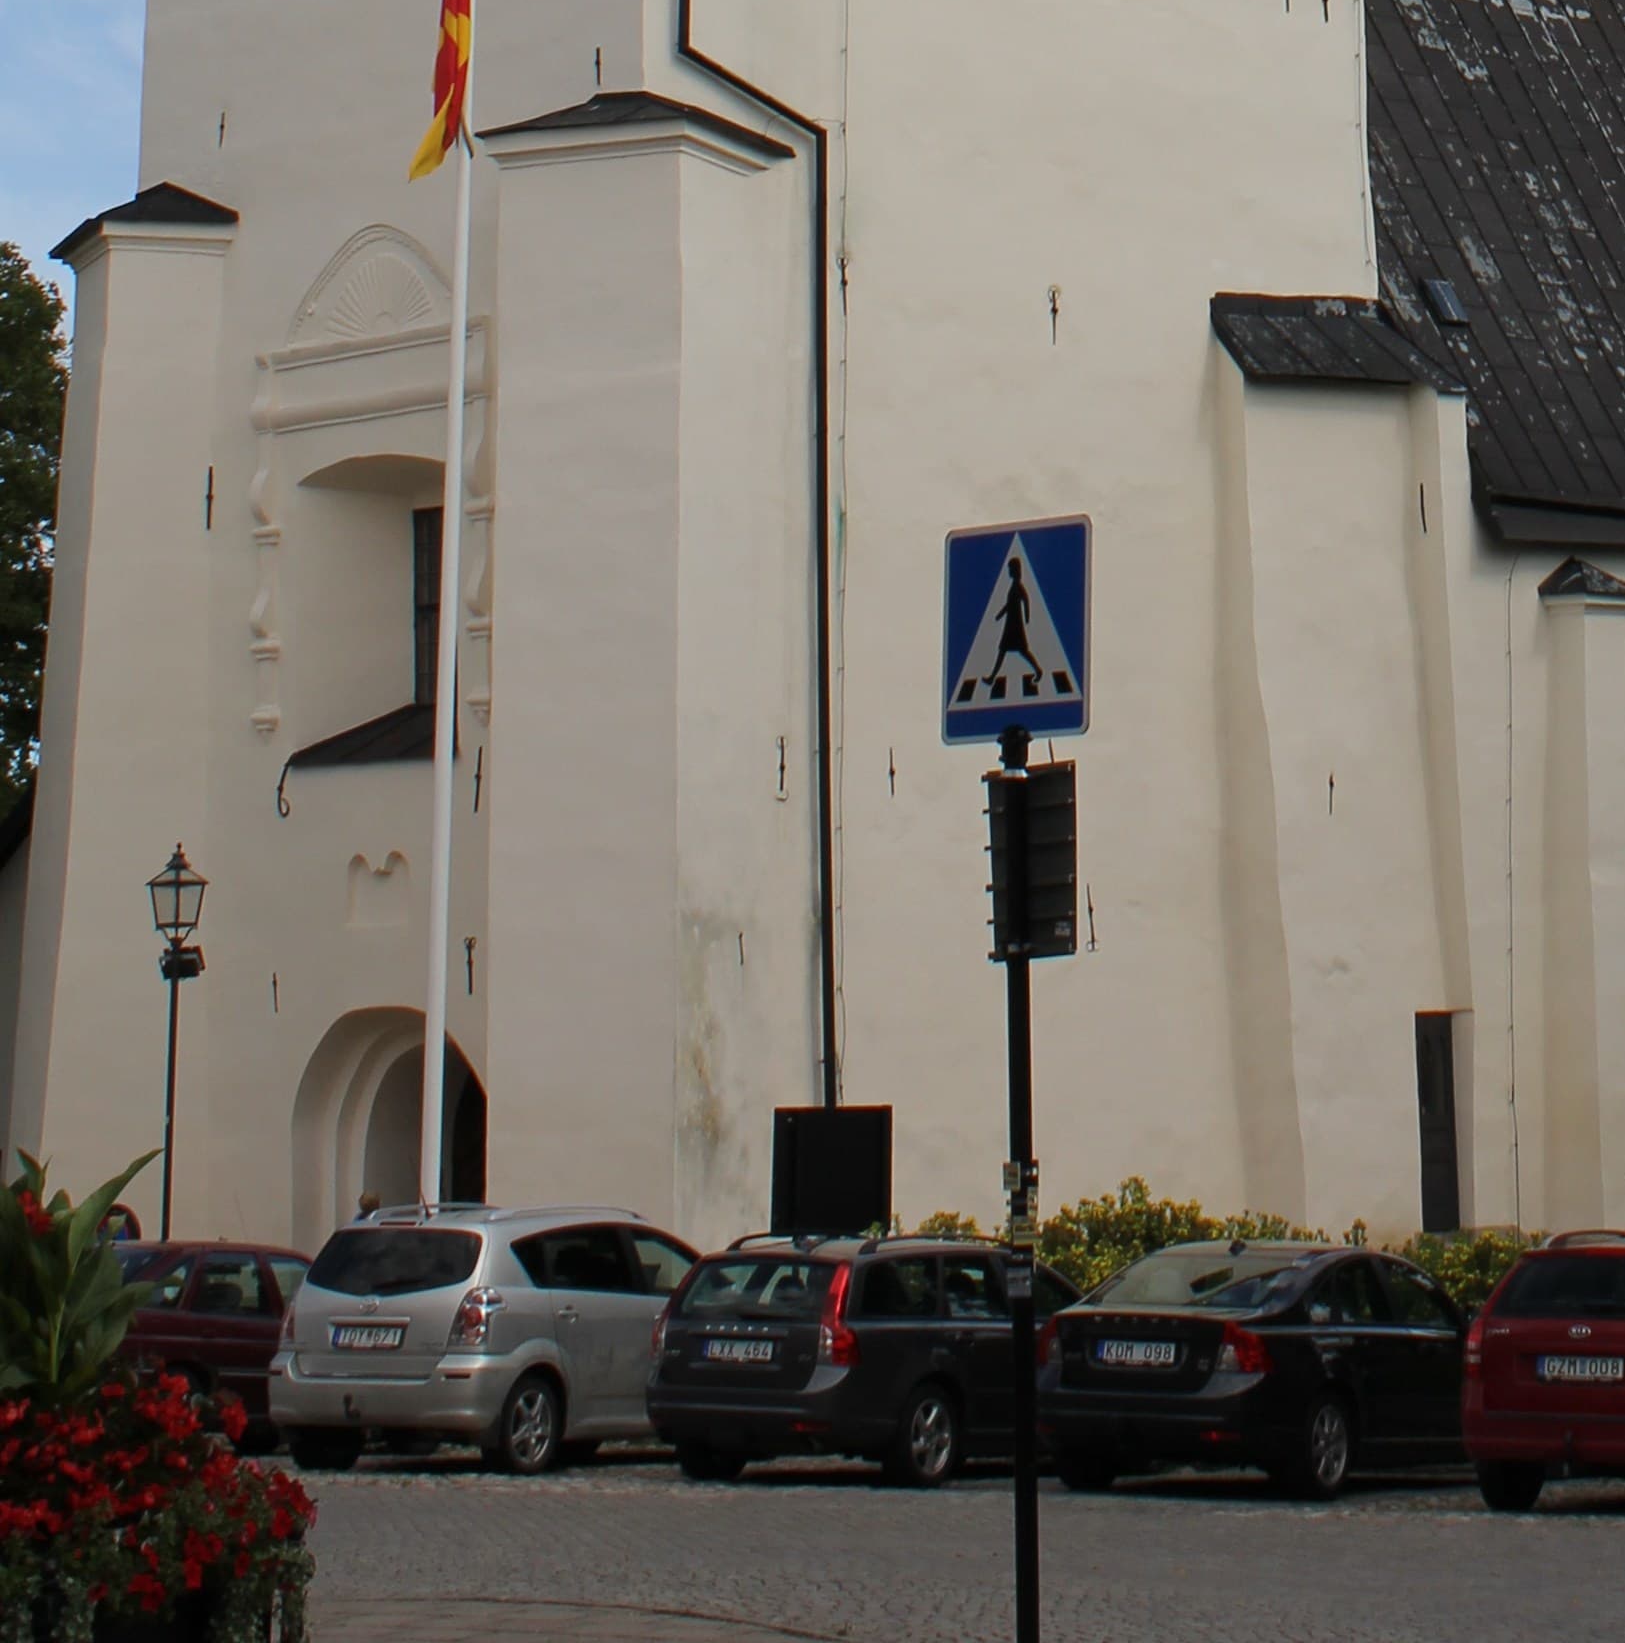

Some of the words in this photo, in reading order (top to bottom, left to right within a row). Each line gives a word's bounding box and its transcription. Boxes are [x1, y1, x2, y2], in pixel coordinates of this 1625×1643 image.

[708, 1342, 735, 1358] LXX
[743, 1342, 770, 1359] 464
[1143, 1343, 1172, 1360] 098
[1546, 1357, 1577, 1375] GZM
[1588, 1357, 1620, 1376] 008
